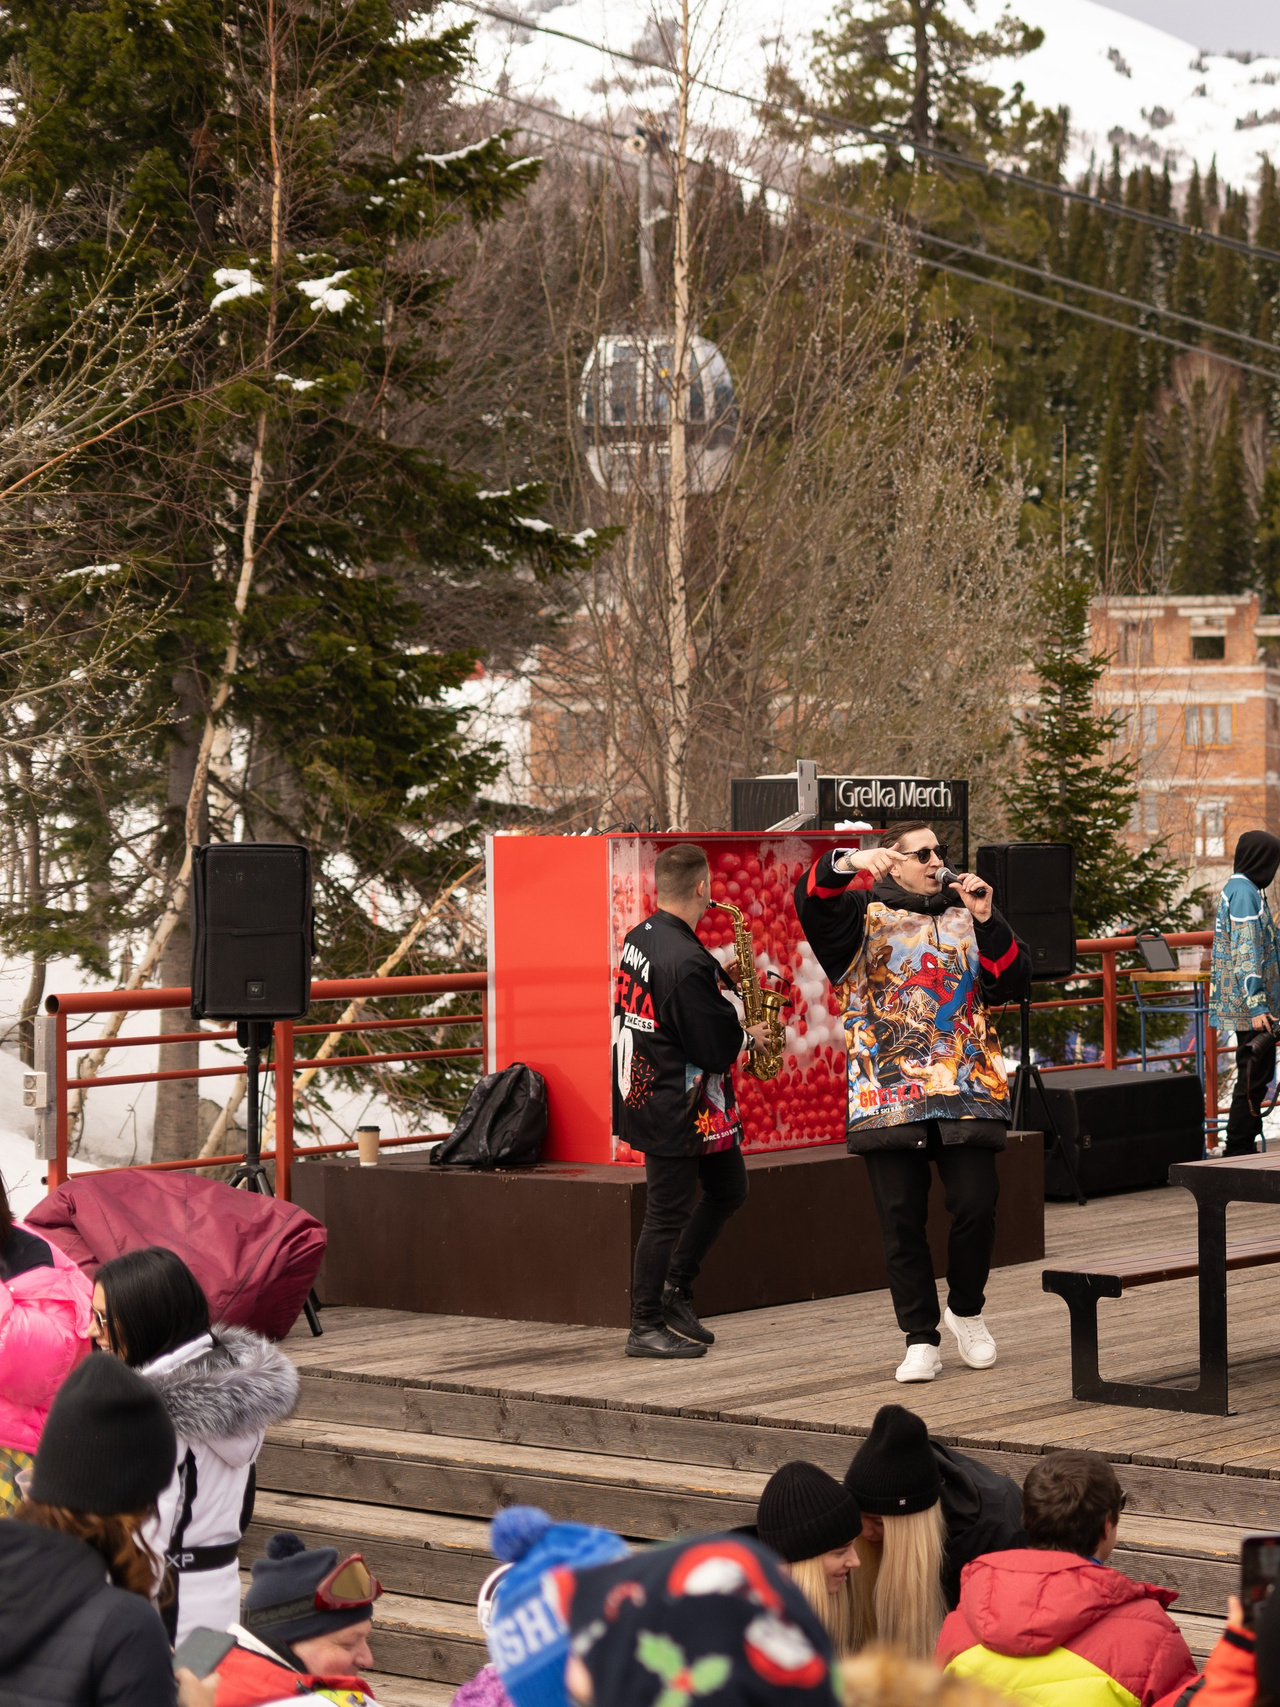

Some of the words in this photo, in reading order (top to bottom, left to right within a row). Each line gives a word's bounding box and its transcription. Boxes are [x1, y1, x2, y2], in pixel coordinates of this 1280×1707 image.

[838, 780, 896, 808] Grelka
[900, 781, 952, 808] Merch
[860, 1084, 920, 1108] GRELKA
